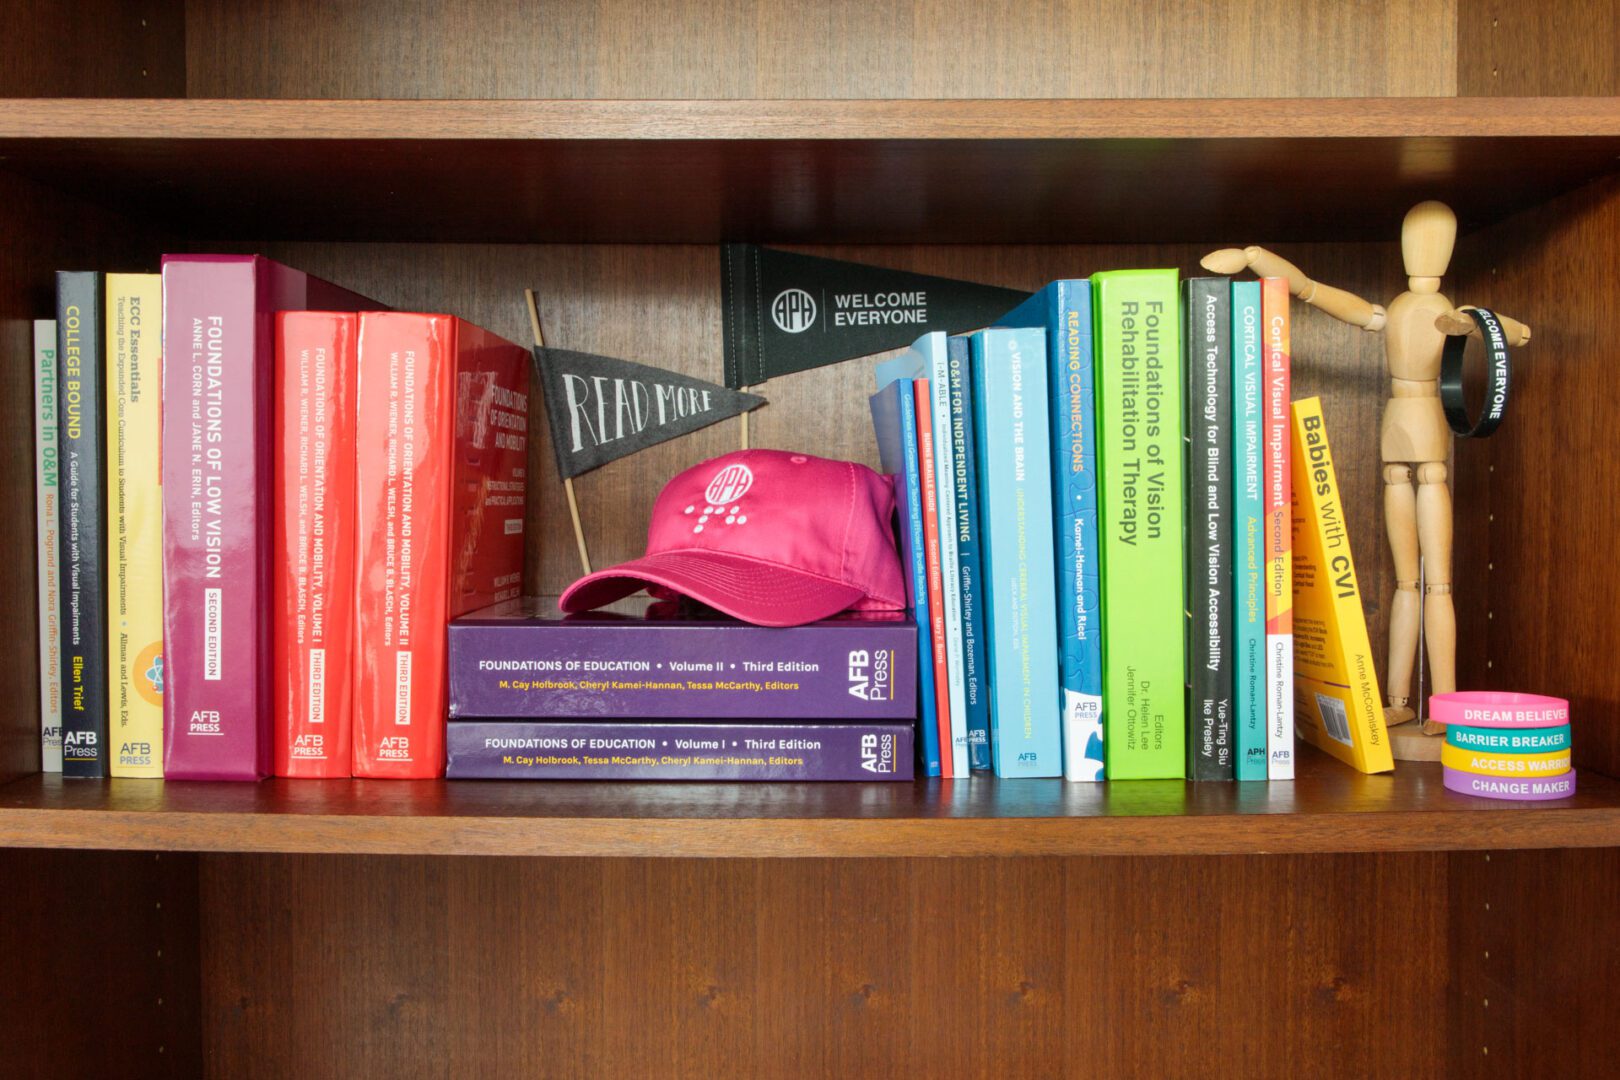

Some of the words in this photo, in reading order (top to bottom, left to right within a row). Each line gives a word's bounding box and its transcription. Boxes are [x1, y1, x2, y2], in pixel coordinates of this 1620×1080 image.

[130, 296, 140, 325] ECC
[834, 292, 927, 308] WELCOME
[834, 309, 928, 326] EVERYONE
[1207, 295, 1217, 342] Access
[67, 306, 80, 376] COLLEGE
[193, 318, 202, 349] ANNE
[1069, 312, 1080, 370] READING
[1244, 306, 1255, 368] CORTICAL
[1272, 316, 1283, 372] Cortical
[130, 330, 140, 402] Essentials
[193, 353, 202, 362] L.
[950, 360, 961, 388] O&M
[1012, 353, 1021, 390] VISION
[1146, 301, 1164, 437] Foundations
[40, 349, 56, 420] Partners
[193, 366, 202, 396] CORN
[207, 316, 222, 442] FOUNDATIONS
[404, 350, 414, 424] FOUNDATIONS
[1122, 302, 1139, 451] Rehabilitation
[1205, 346, 1218, 421] Technology
[1245, 372, 1256, 417] VISUAL
[1488, 352, 1506, 419] EVERYONE
[68, 381, 80, 439] BOUND
[192, 399, 202, 418] and
[562, 374, 650, 454] READ
[654, 383, 712, 426] MORE
[952, 392, 963, 414] FOR
[1013, 392, 1023, 418] AND
[1273, 377, 1284, 419] Visual
[42, 426, 57, 440] in
[192, 422, 201, 450] JANE
[404, 427, 414, 441] OF
[1015, 420, 1023, 443] THE
[1070, 374, 1083, 472] CONNECTIONS
[1208, 425, 1218, 443] for
[43, 446, 57, 486] O&M
[192, 454, 201, 464] N.
[207, 448, 222, 470] OF
[953, 418, 967, 499] INDEPENDENT
[1016, 447, 1025, 480] BRAIN
[1147, 444, 1164, 465] of
[1208, 448, 1219, 481] Blind
[1246, 421, 1257, 500] IMPAIRMENT
[1270, 425, 1285, 506] Impairment
[1303, 416, 1330, 496] Babies
[70, 461, 78, 486] Guide
[191, 468, 201, 498] ERIN,
[403, 443, 413, 512] ORIENTATION
[207, 476, 221, 515] LOW
[1119, 458, 1140, 546] Therapy
[1148, 472, 1164, 538] Vision
[1208, 485, 1218, 509] and
[71, 503, 79, 540] Students
[192, 502, 201, 540] Editors
[402, 514, 412, 536] AND
[958, 503, 970, 542] LIVING
[1209, 513, 1219, 540] Low
[1274, 512, 1283, 554] Second
[1321, 502, 1344, 548] with
[72, 542, 80, 561] with
[206, 520, 221, 578] VISION
[1074, 518, 1085, 593] Kamei-Hannan
[1247, 516, 1257, 569] Advanced
[72, 564, 80, 589] Visual
[400, 538, 412, 590] MOBILITY,
[1209, 544, 1220, 585] Vision
[1274, 557, 1284, 597] Edition
[1332, 556, 1355, 598] CVI
[962, 566, 973, 620] Griffin-Shirley
[1077, 595, 1086, 613] and
[1247, 572, 1258, 622] Principles
[71, 592, 80, 645] Impairments
[208, 592, 217, 632] SECOND
[400, 594, 410, 636] VOLUME
[966, 622, 974, 636] and
[1078, 616, 1086, 639] Ricci
[1207, 588, 1220, 671] Accessibility
[73, 656, 83, 683] Ellen
[208, 636, 217, 676] EDITION
[399, 654, 408, 682] THIRD
[479, 661, 562, 671] FOUNDATIONS
[566, 661, 581, 670] OF
[584, 662, 650, 670] EDUCATION
[670, 662, 714, 671] Volume
[716, 662, 724, 671] II
[743, 662, 775, 671] Third
[777, 662, 819, 672] Edition
[966, 639, 976, 677] Bozeman,
[512, 681, 530, 691] Cay
[532, 681, 578, 689] Holbrook,
[580, 681, 609, 691] Cheryl
[612, 681, 684, 690] Kamei-Hannan,
[716, 682, 763, 691] McCarthy,
[849, 650, 868, 700] AFB
[870, 650, 888, 700] Press
[969, 678, 978, 705] Editors
[1126, 666, 1136, 705] Jennifer
[1141, 681, 1150, 693] Dr.
[73, 685, 83, 711] Trief
[191, 710, 220, 723] AFB
[399, 685, 408, 722] EDITION
[1075, 702, 1097, 711] AFB
[1141, 698, 1150, 728] Helen
[1204, 699, 1213, 714] Ike
[1356, 654, 1366, 680] Anne
[1362, 682, 1380, 746] McComiskey
[1464, 710, 1512, 721] DREAM
[64, 731, 97, 744] AFB
[1127, 709, 1136, 750] Ottowitz
[1155, 714, 1164, 749] Editors
[1202, 718, 1213, 757] Presley
[1217, 699, 1228, 744] Yue-Ting
[1456, 732, 1509, 746] BARRIER
[1512, 734, 1564, 747] BREAKER
[64, 745, 98, 756] Press
[120, 743, 150, 754] AFB
[485, 739, 568, 748] FOUNDATIONS
[571, 739, 586, 748] OF
[590, 739, 655, 748] EDUCATION
[676, 740, 718, 749] Volume
[722, 740, 725, 748] I
[745, 740, 776, 749] Third
[779, 740, 821, 749] Edition
[861, 734, 877, 772] AFB
[878, 734, 892, 772] Press
[1141, 731, 1150, 750] Lee
[1219, 748, 1228, 765] Siu
[516, 756, 533, 766] Cay
[536, 756, 581, 765] Holbrook,
[612, 757, 658, 766] McCarthy,
[661, 757, 690, 766] Cheryl
[694, 757, 767, 766] Kamei-Hannan,
[1472, 758, 1525, 771] ACCESS
[1472, 780, 1529, 794] CHANGE
[1532, 780, 1570, 794] MAKER
